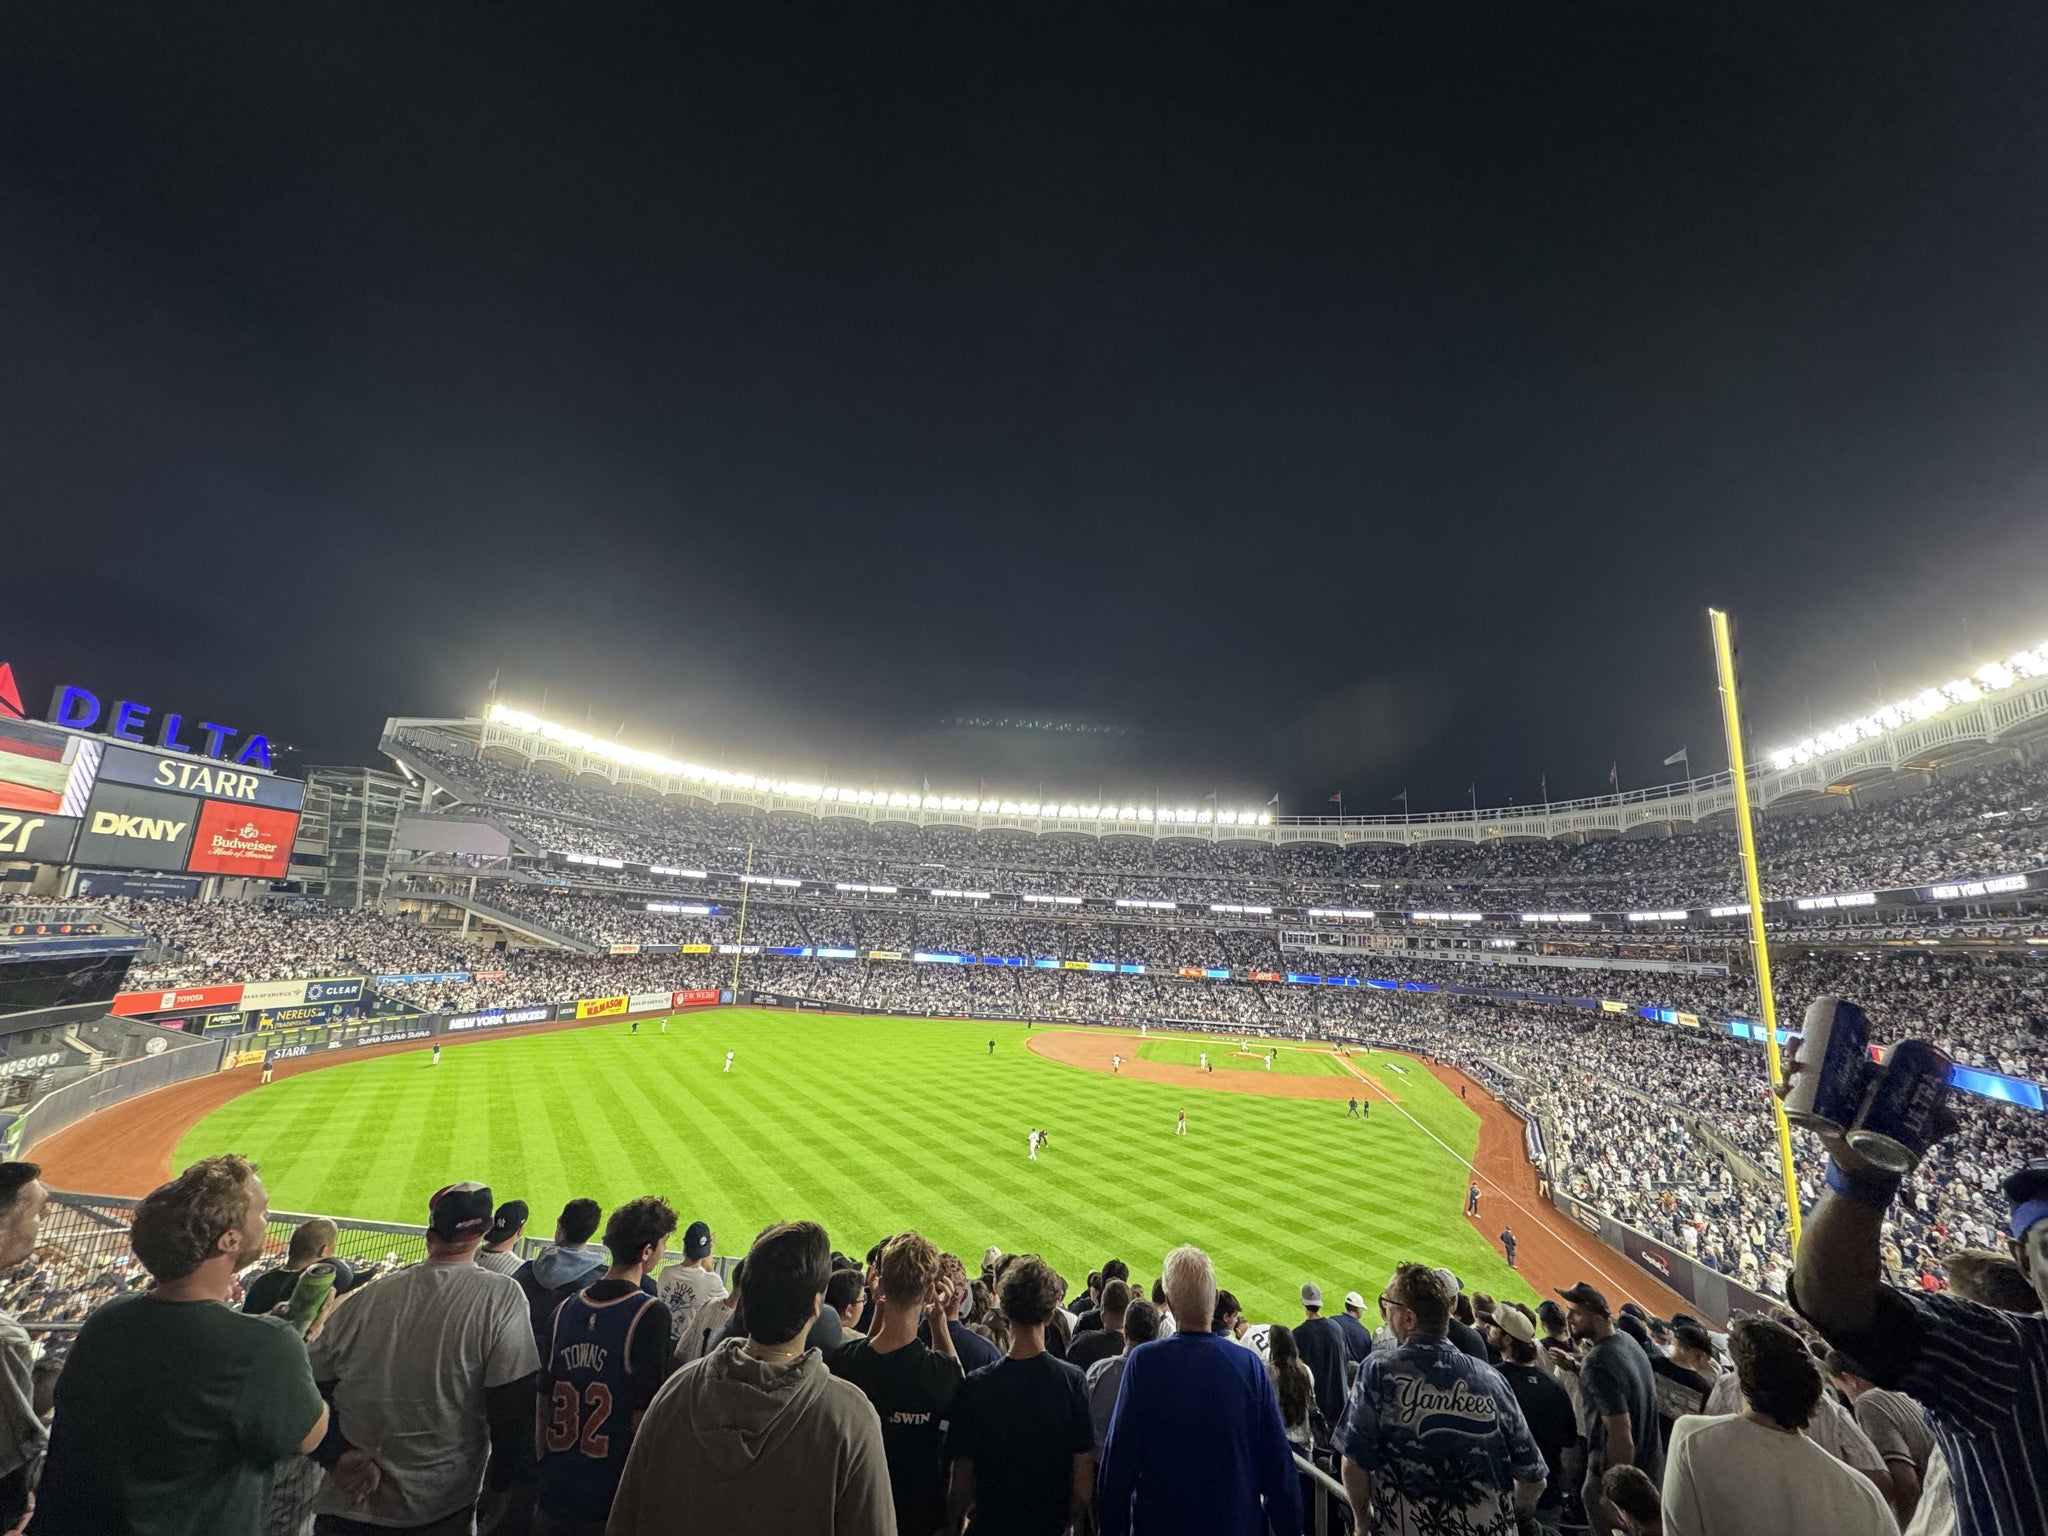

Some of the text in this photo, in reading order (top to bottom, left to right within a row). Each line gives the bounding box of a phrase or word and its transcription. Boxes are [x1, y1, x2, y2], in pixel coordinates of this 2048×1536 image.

[50, 685, 272, 769] DELTA
[153, 760, 259, 800] STARR
[91, 811, 187, 842] DKNY
[211, 834, 277, 852] Budweiser
[176, 994, 204, 1003] TOYOTA
[326, 986, 357, 995] CLEAR
[212, 1014, 240, 1022] ARENA
[276, 1008, 317, 1020] NEREUS
[449, 1009, 547, 1030] NEW YORK YANKEES
[274, 1045, 307, 1059] STARR
[561, 1343, 608, 1372] TOWNS
[1395, 1377, 1496, 1423] Yankees
[546, 1380, 613, 1459] 32
